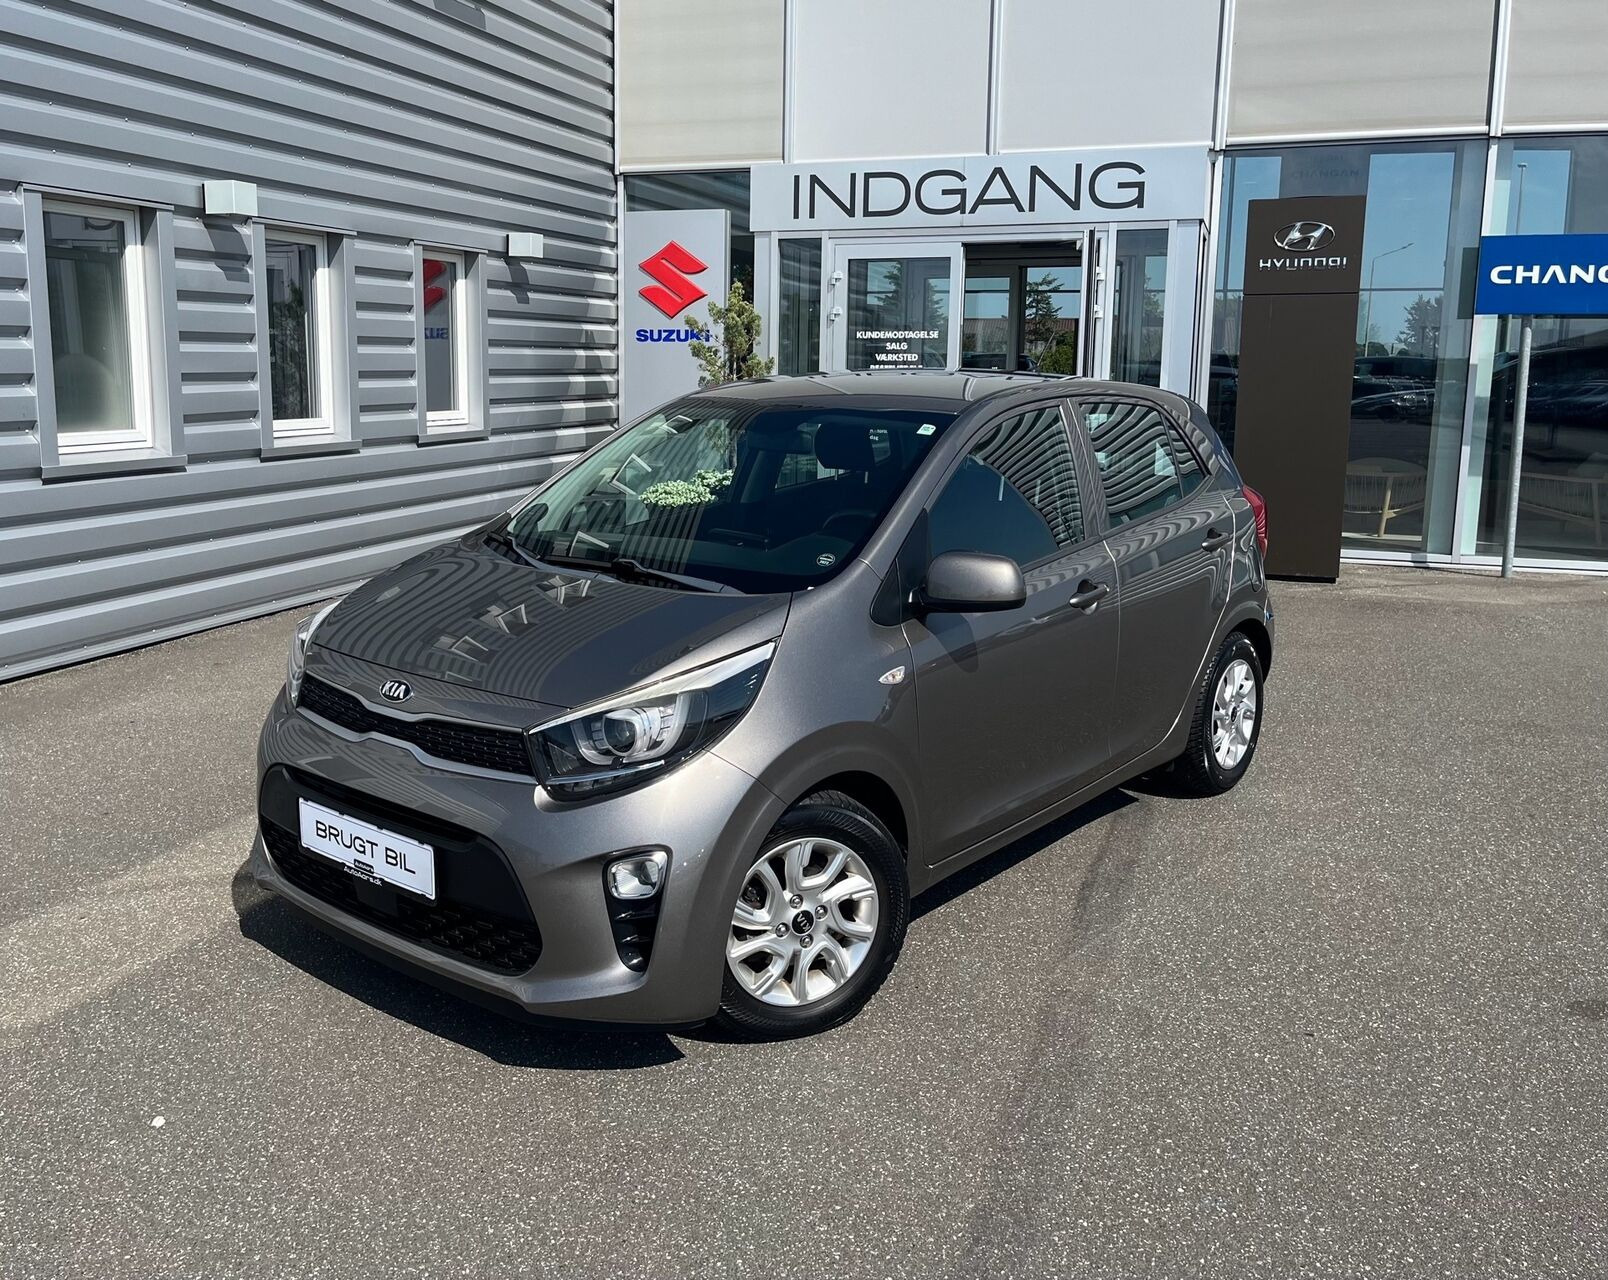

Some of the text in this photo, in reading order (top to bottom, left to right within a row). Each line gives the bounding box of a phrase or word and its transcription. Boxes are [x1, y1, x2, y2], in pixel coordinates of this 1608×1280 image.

[792, 160, 1146, 220] INDGANG
[1259, 256, 1347, 271] HYUNDAI
[856, 330, 939, 339] KUNDEMODTAGELSE
[885, 342, 908, 350] SALG
[875, 353, 918, 361] VÆRKSTED
[382, 681, 406, 699] KIA
[315, 819, 416, 875] BRUGT BIL
[797, 913, 811, 932] KIA
